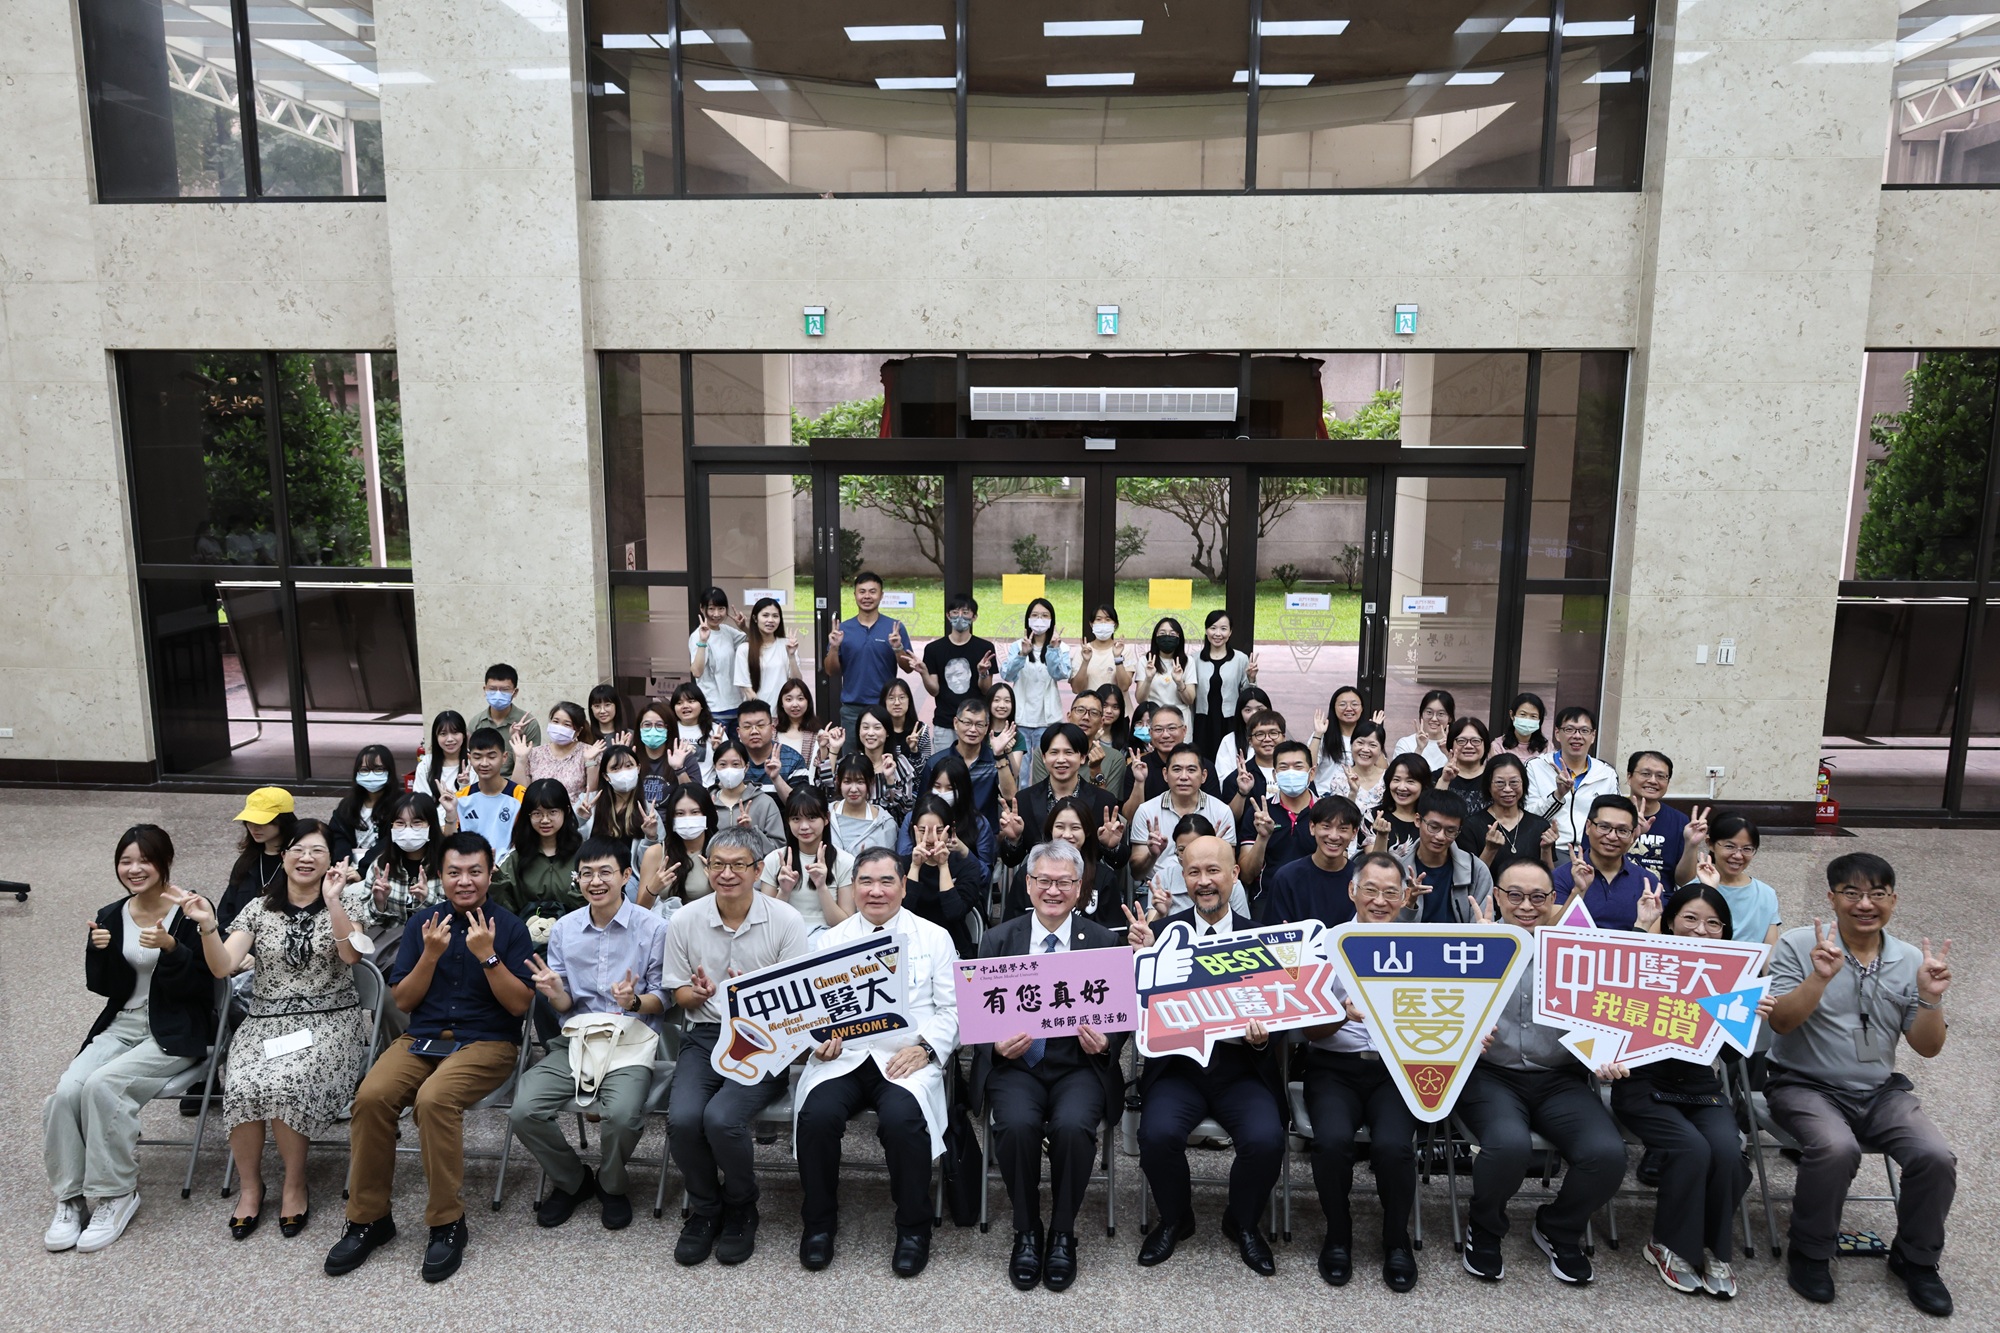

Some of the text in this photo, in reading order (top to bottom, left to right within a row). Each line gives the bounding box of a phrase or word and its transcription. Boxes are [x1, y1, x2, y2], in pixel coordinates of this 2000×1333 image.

[1640, 834, 1665, 845] MP
[980, 961, 1039, 975] 中山醫學大學
[1195, 946, 1275, 976] BEST
[814, 961, 881, 990] Chung Shan
[1555, 943, 1723, 1014] 中山醫大
[743, 976, 896, 1024] 中山醫大
[983, 978, 1110, 1014] 有您真好
[1153, 981, 1309, 1031] 中山醫大
[768, 1013, 804, 1032] Medical
[785, 1016, 831, 1036] University
[830, 1018, 889, 1039] AWESOME
[1041, 1012, 1128, 1030] 教師節感恩活動
